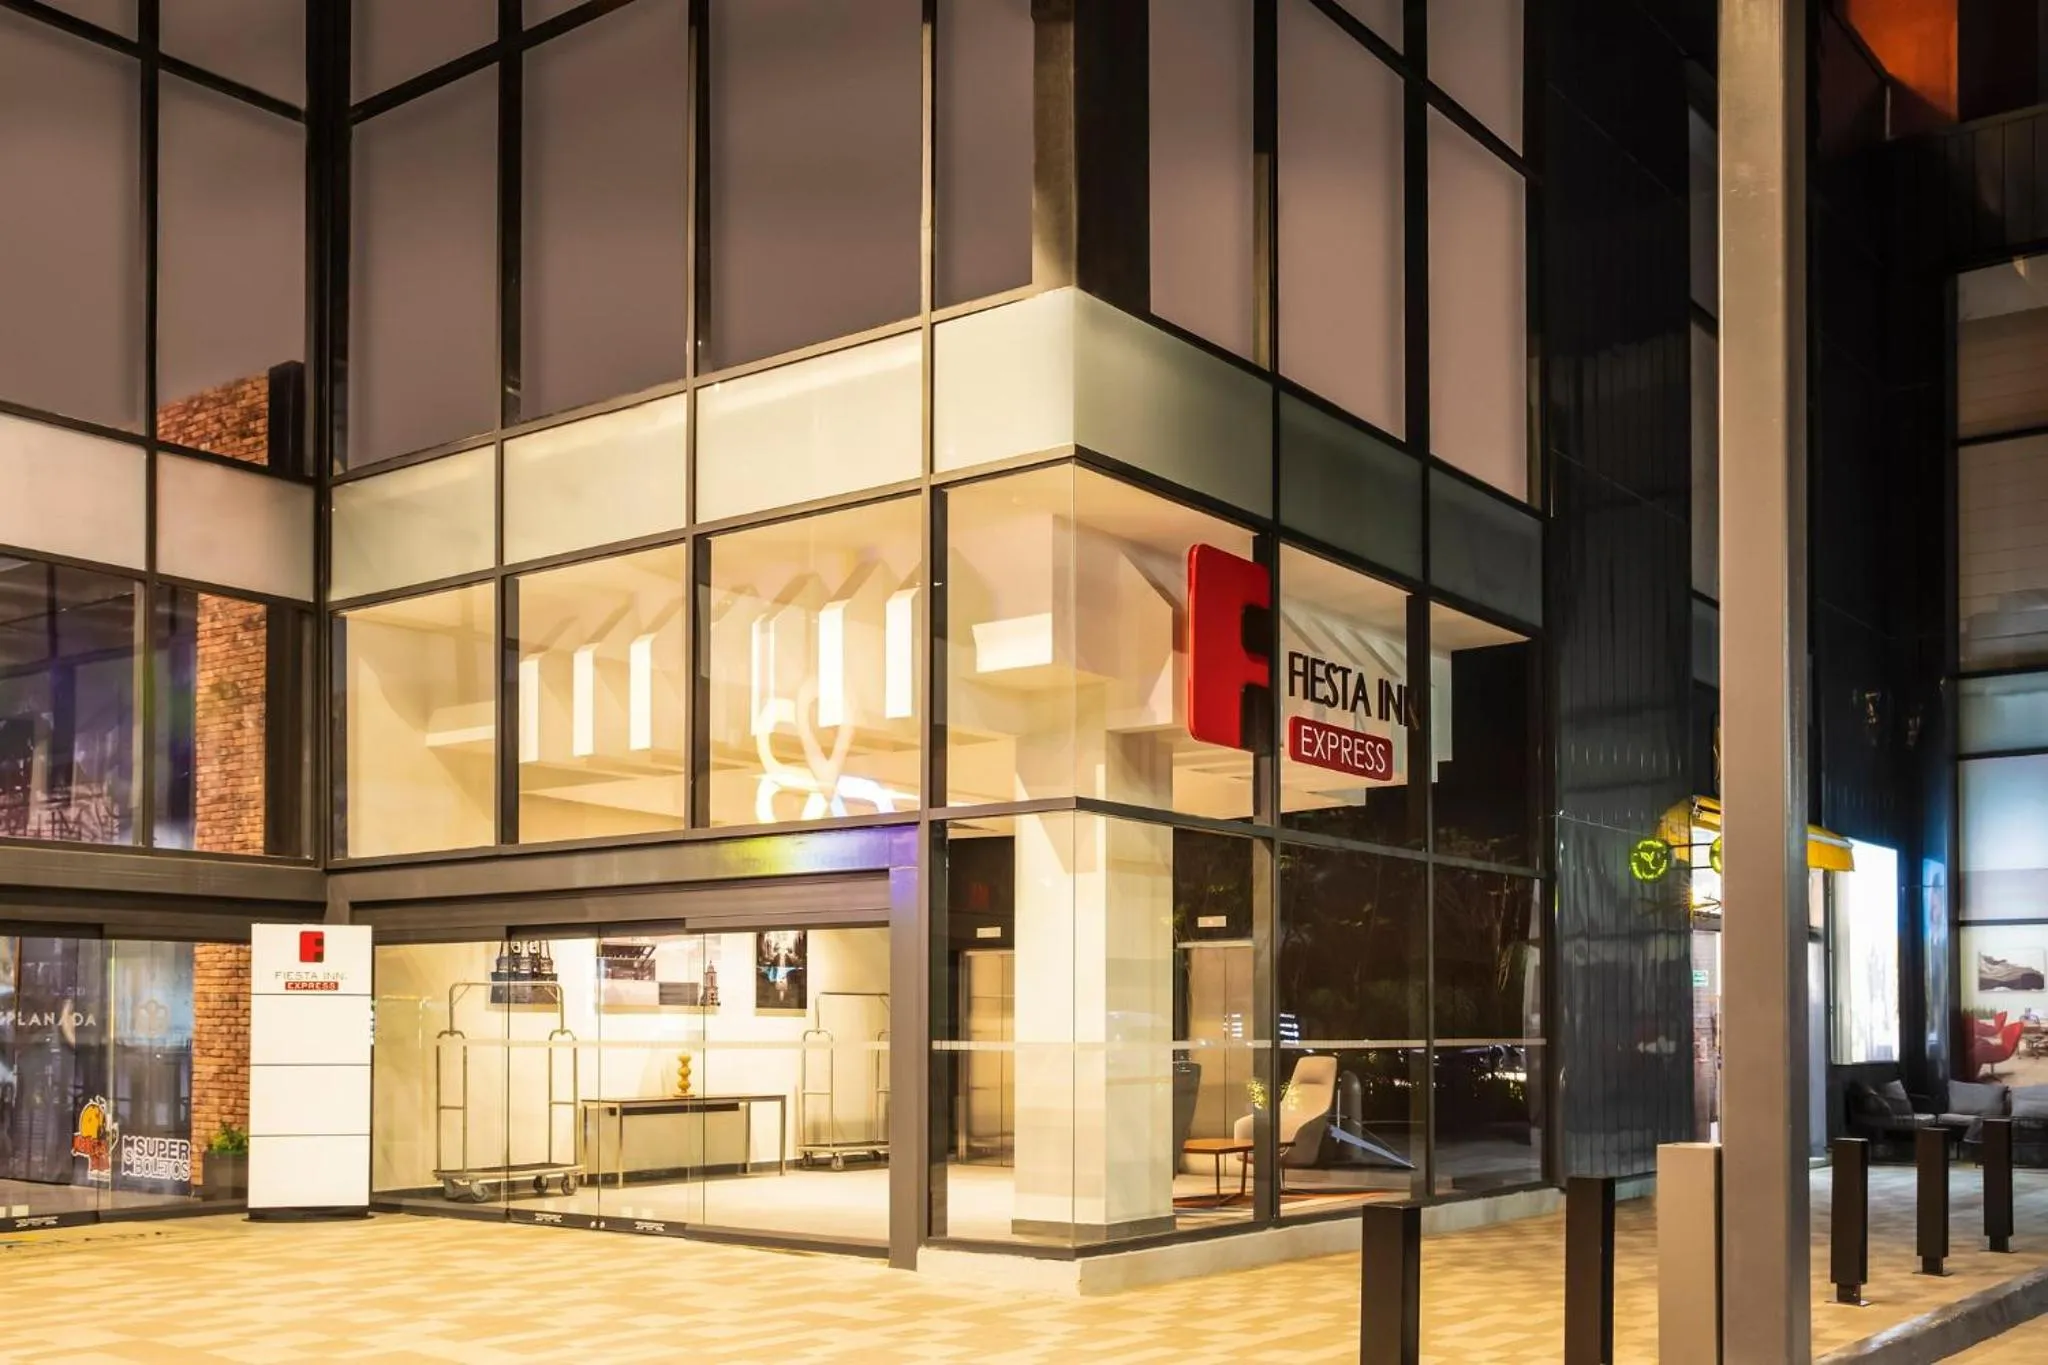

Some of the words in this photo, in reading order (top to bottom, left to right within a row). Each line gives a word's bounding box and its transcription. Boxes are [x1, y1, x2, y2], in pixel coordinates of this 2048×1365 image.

[1288, 651, 1372, 718] FIESTA
[1300, 725, 1386, 773] EXPRESS
[274, 971, 318, 981] FIESTA
[286, 982, 337, 990] EXPRESS
[135, 1138, 189, 1160] SUPER
